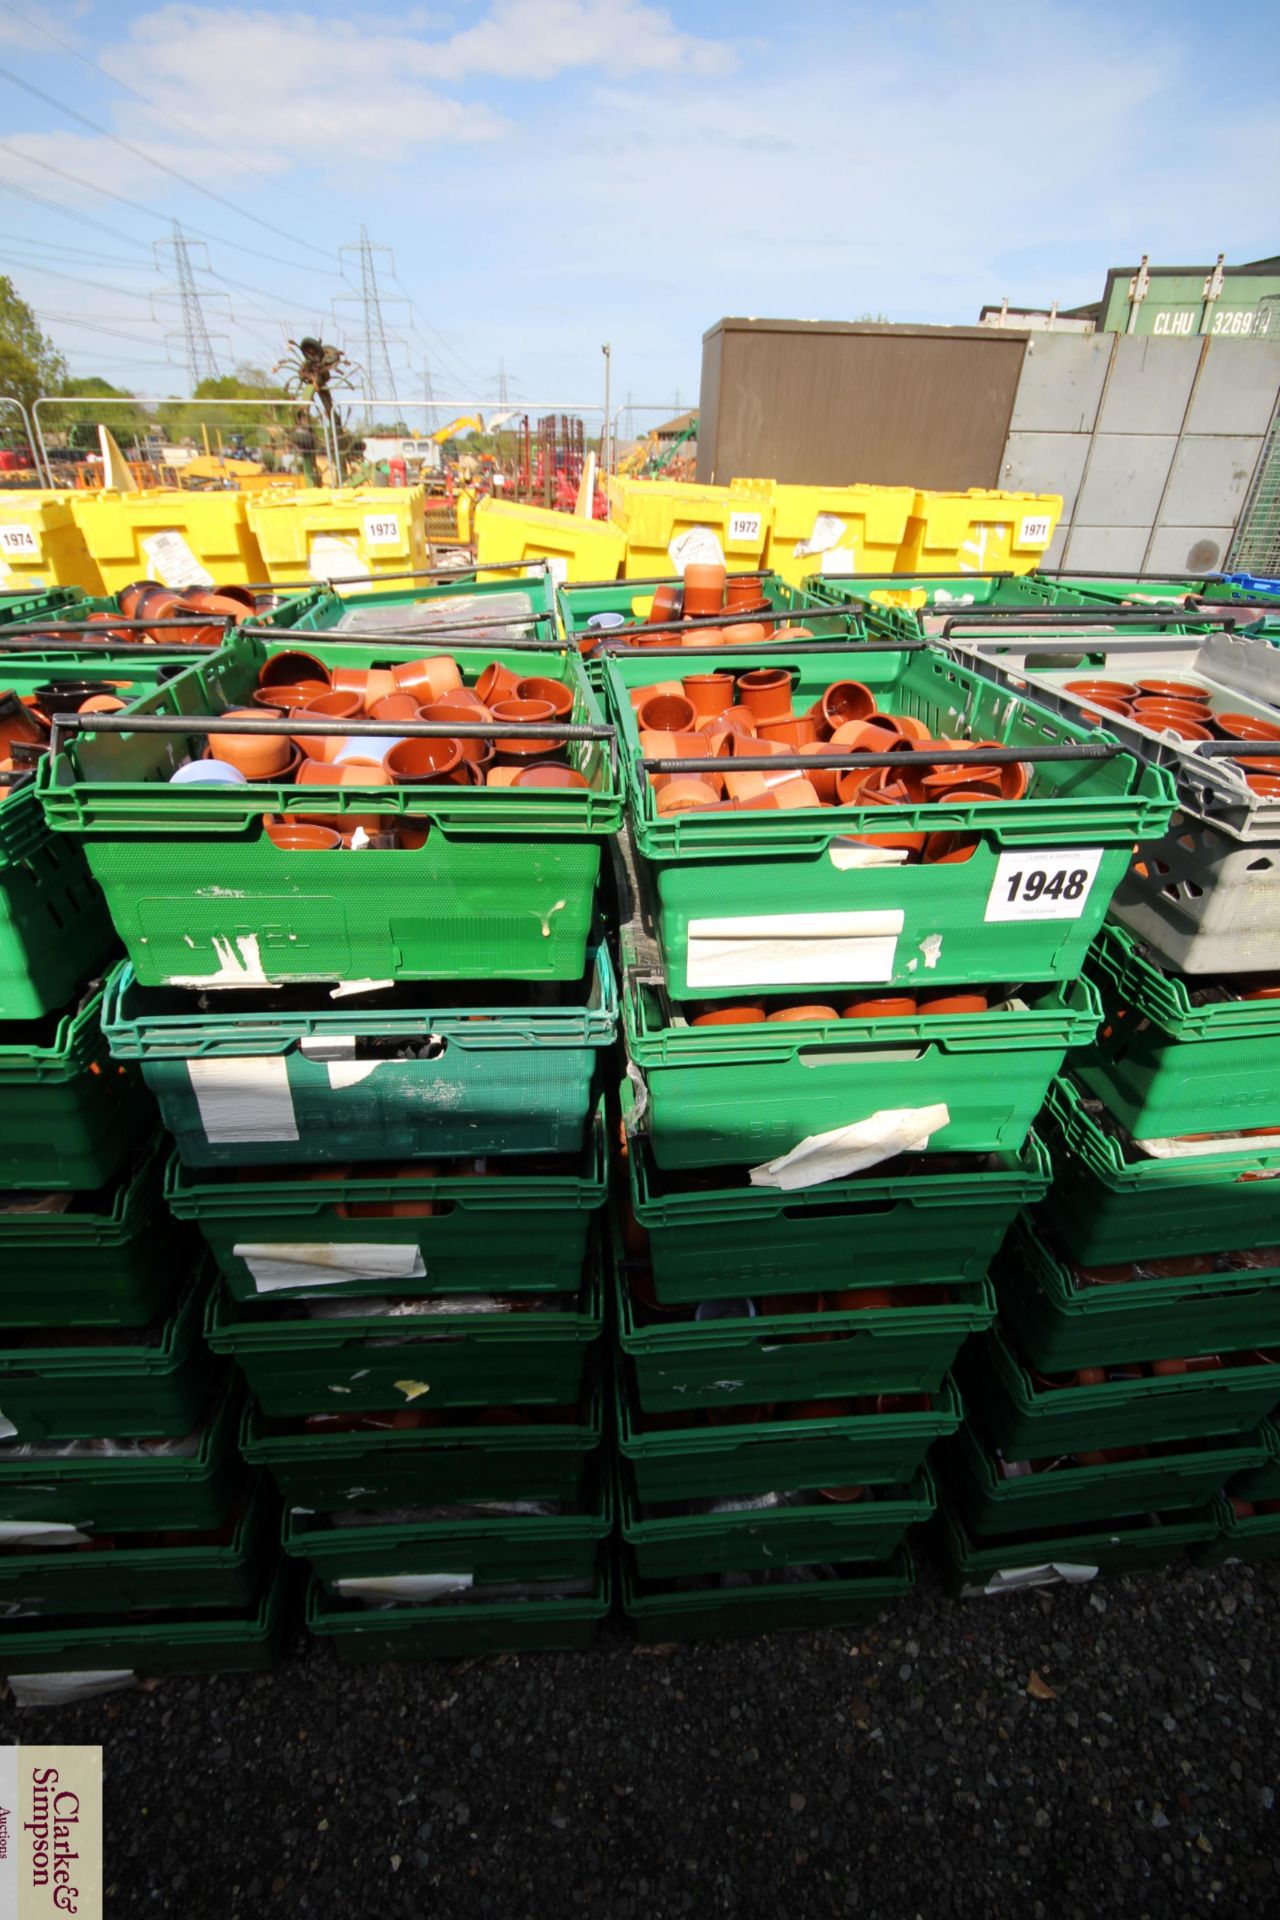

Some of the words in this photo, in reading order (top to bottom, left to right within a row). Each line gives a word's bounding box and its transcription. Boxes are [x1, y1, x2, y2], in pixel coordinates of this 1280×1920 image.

[1153, 311, 1195, 335] CLHU
[370, 523, 397, 536] 1973
[733, 520, 758, 533] 1972
[1024, 524, 1047, 536] 1971
[3, 533, 33, 546] 1974
[1007, 869, 1088, 902] 1948
